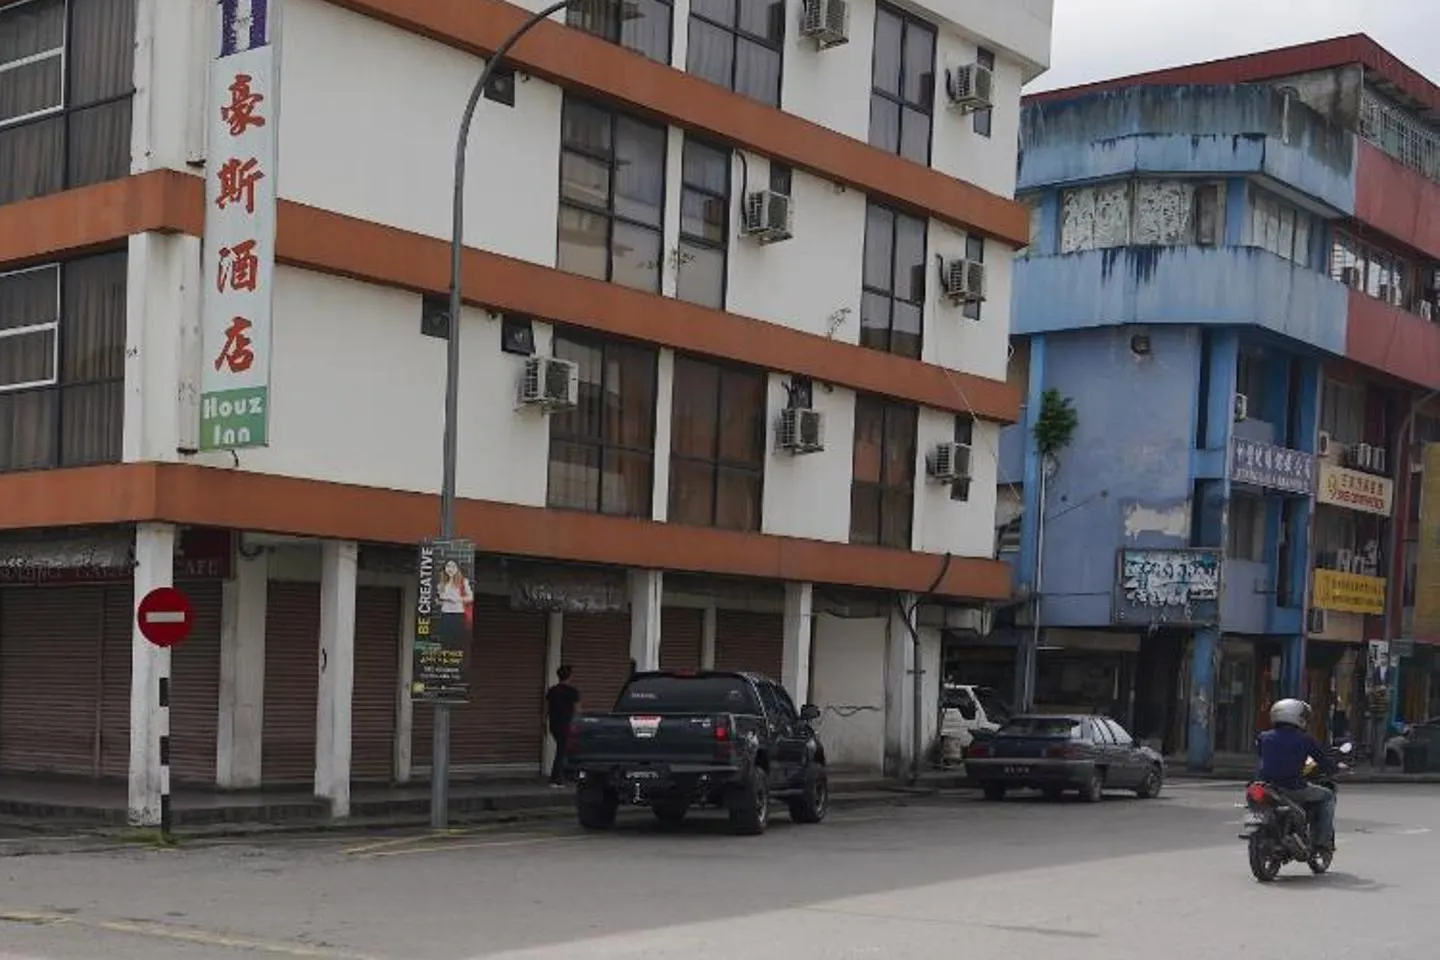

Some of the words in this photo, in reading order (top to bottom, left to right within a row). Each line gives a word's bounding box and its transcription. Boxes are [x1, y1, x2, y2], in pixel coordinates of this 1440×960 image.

[214, 74, 266, 374] 豪斯酒店
[203, 393, 262, 420] Houz
[213, 422, 251, 446] Inn
[418, 546, 433, 614] CREATIVE
[418, 617, 431, 634] BE
